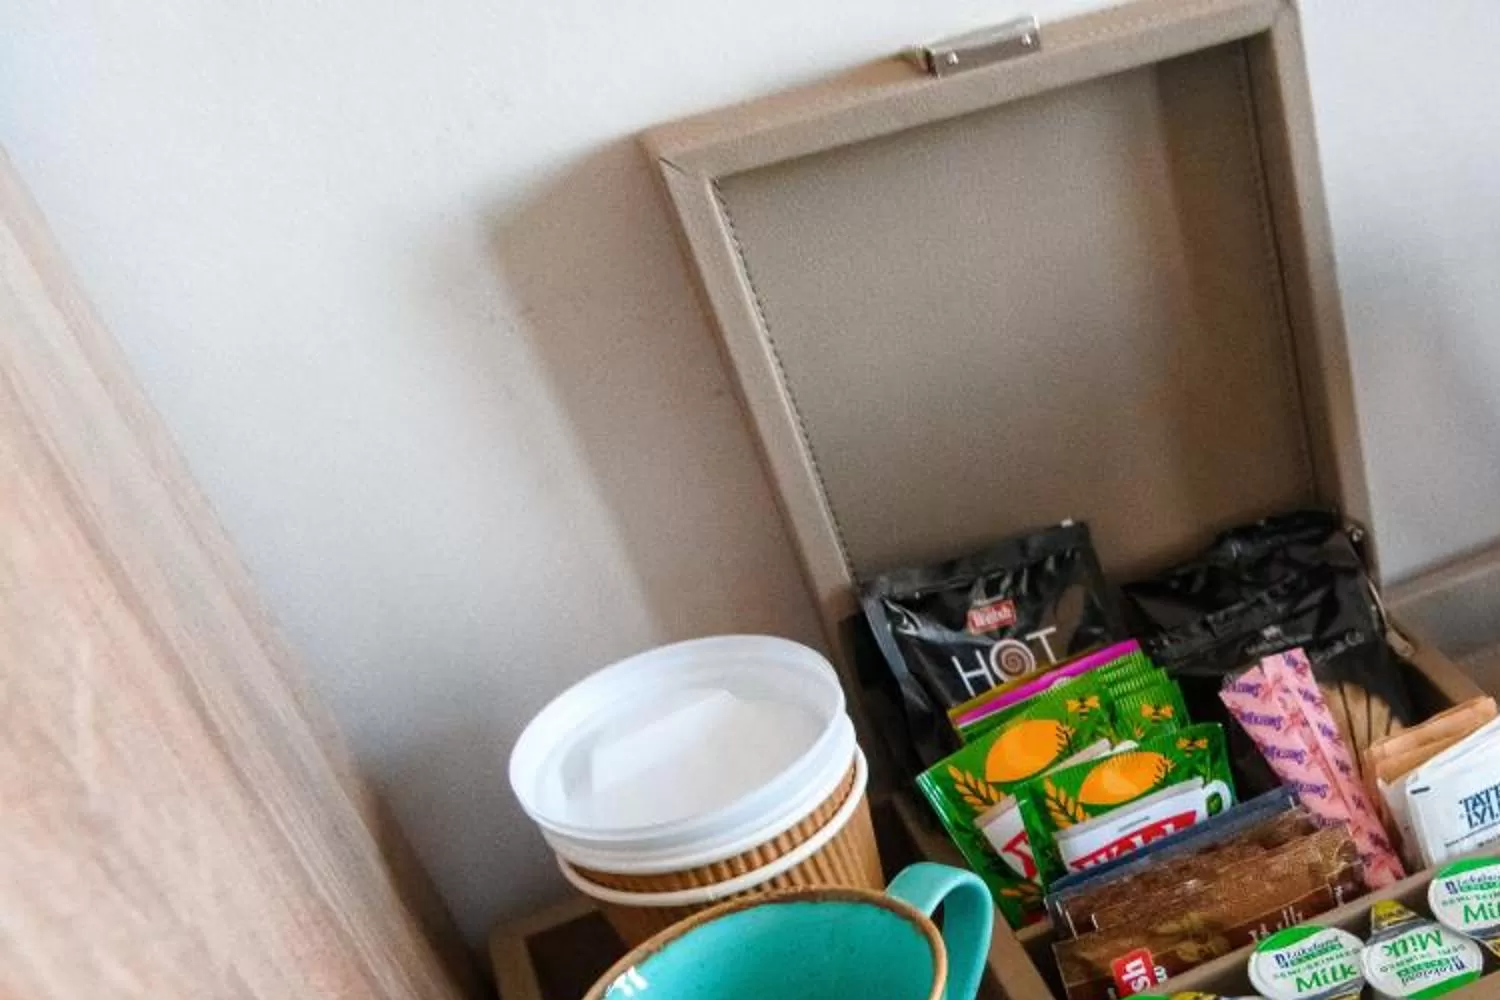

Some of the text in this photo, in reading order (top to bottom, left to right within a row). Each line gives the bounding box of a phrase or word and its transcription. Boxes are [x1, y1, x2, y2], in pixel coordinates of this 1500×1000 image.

[951, 625, 1057, 698] HOT
[1380, 929, 1444, 958] Milk
[1295, 963, 1358, 993] Milk
